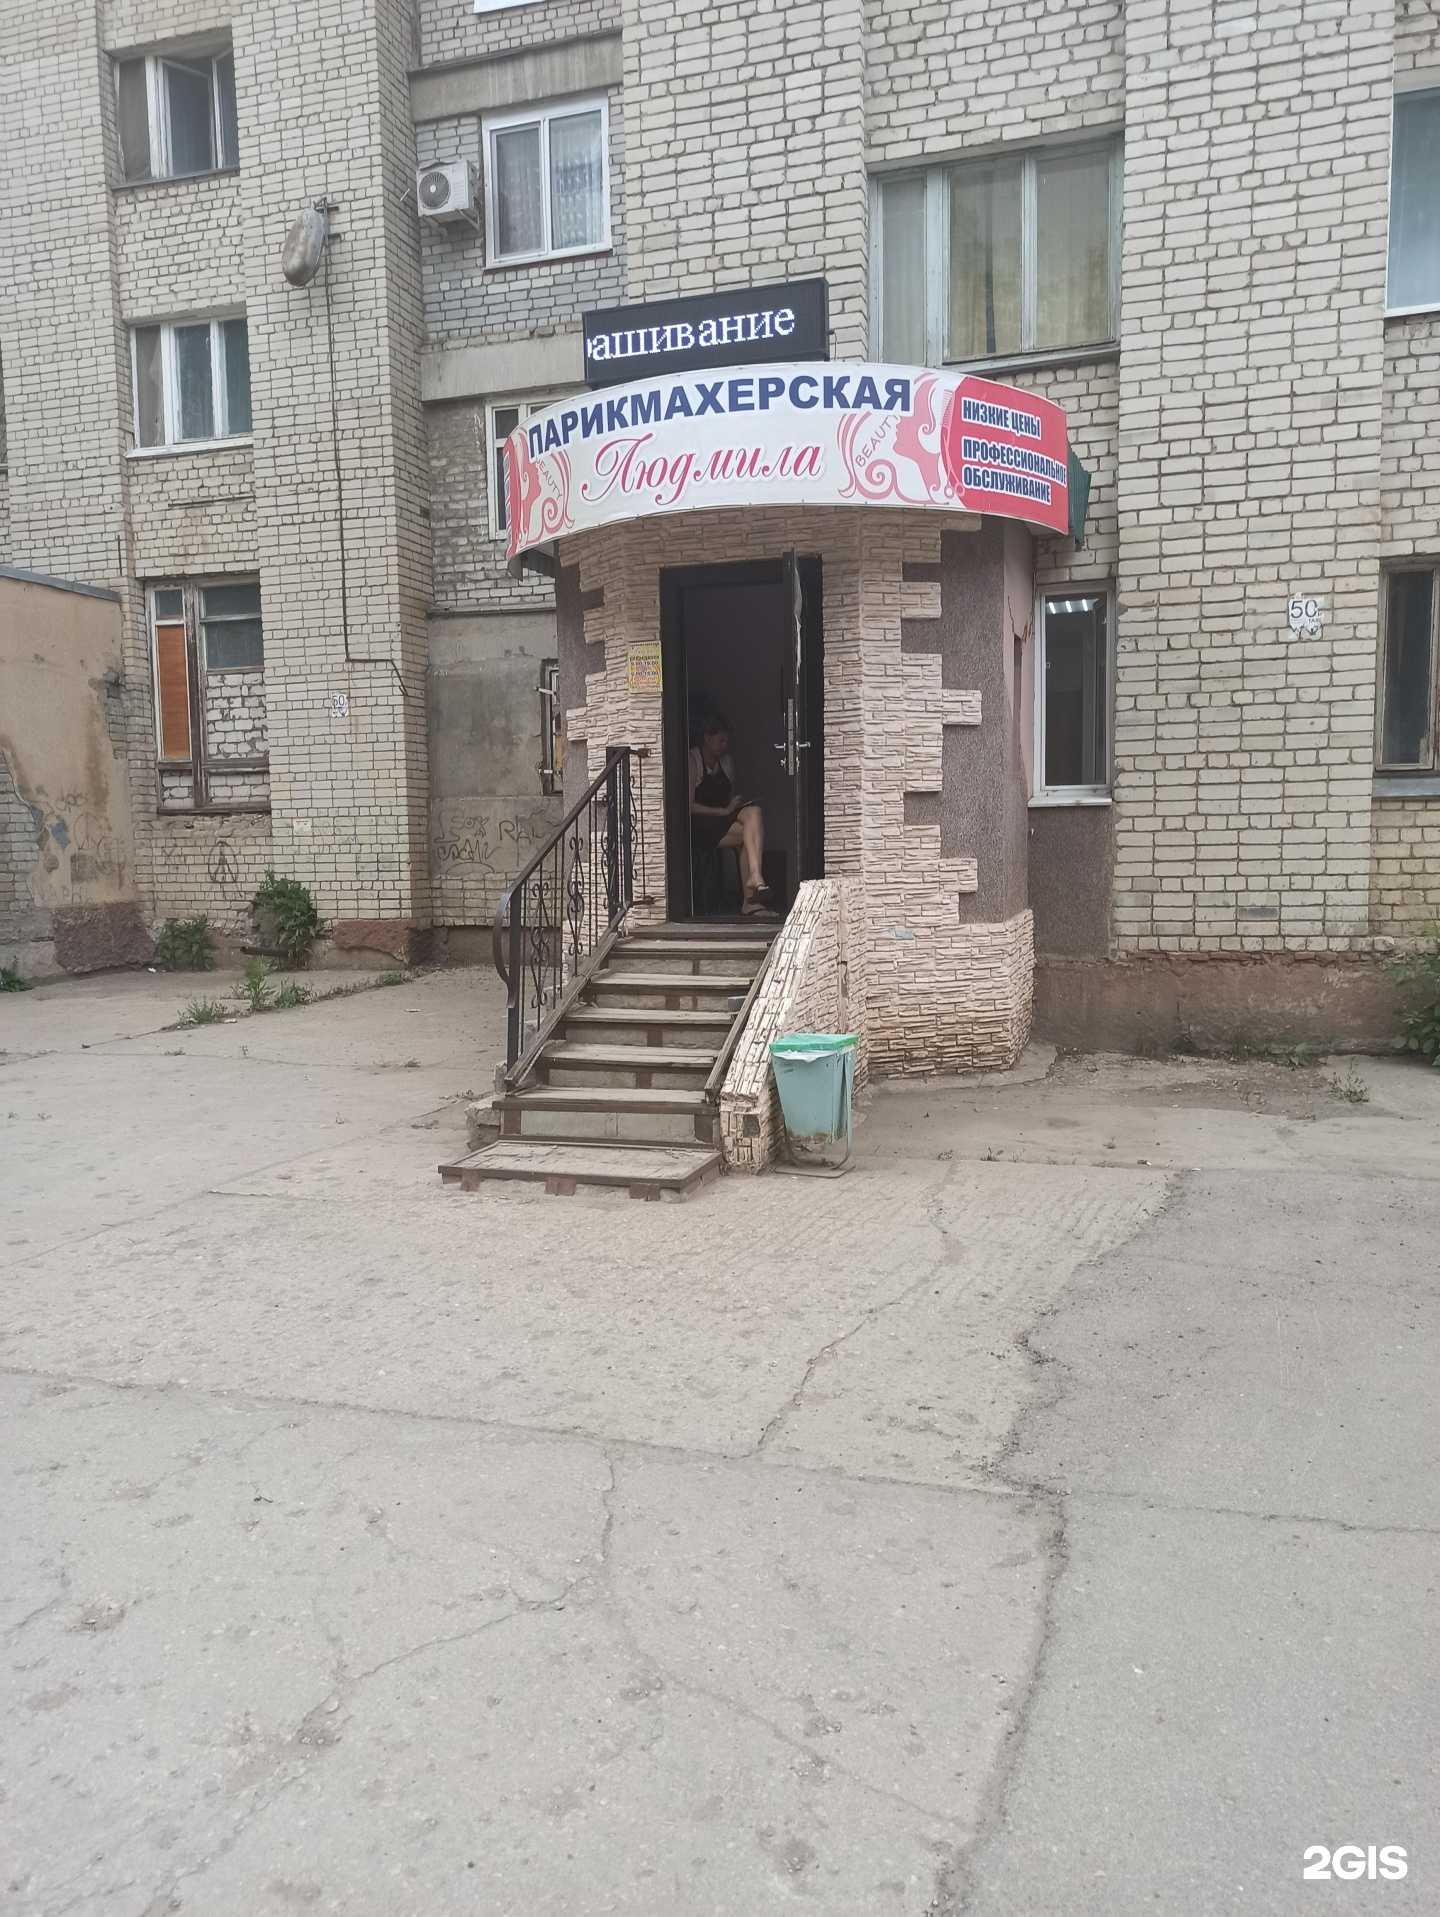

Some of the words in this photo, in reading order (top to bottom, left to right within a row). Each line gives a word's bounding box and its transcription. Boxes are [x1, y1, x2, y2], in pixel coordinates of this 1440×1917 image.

[528, 375, 911, 459] ПАРИКМАХЕРСКАЯ
[962, 398, 1010, 429] НИЗКИЕ
[1011, 411, 1041, 438] ЦЕНЫ
[581, 432, 821, 506] Людмила
[962, 466, 1051, 503] ОБСЛУЖИВАНИЕ
[1290, 599, 1318, 619] 50
